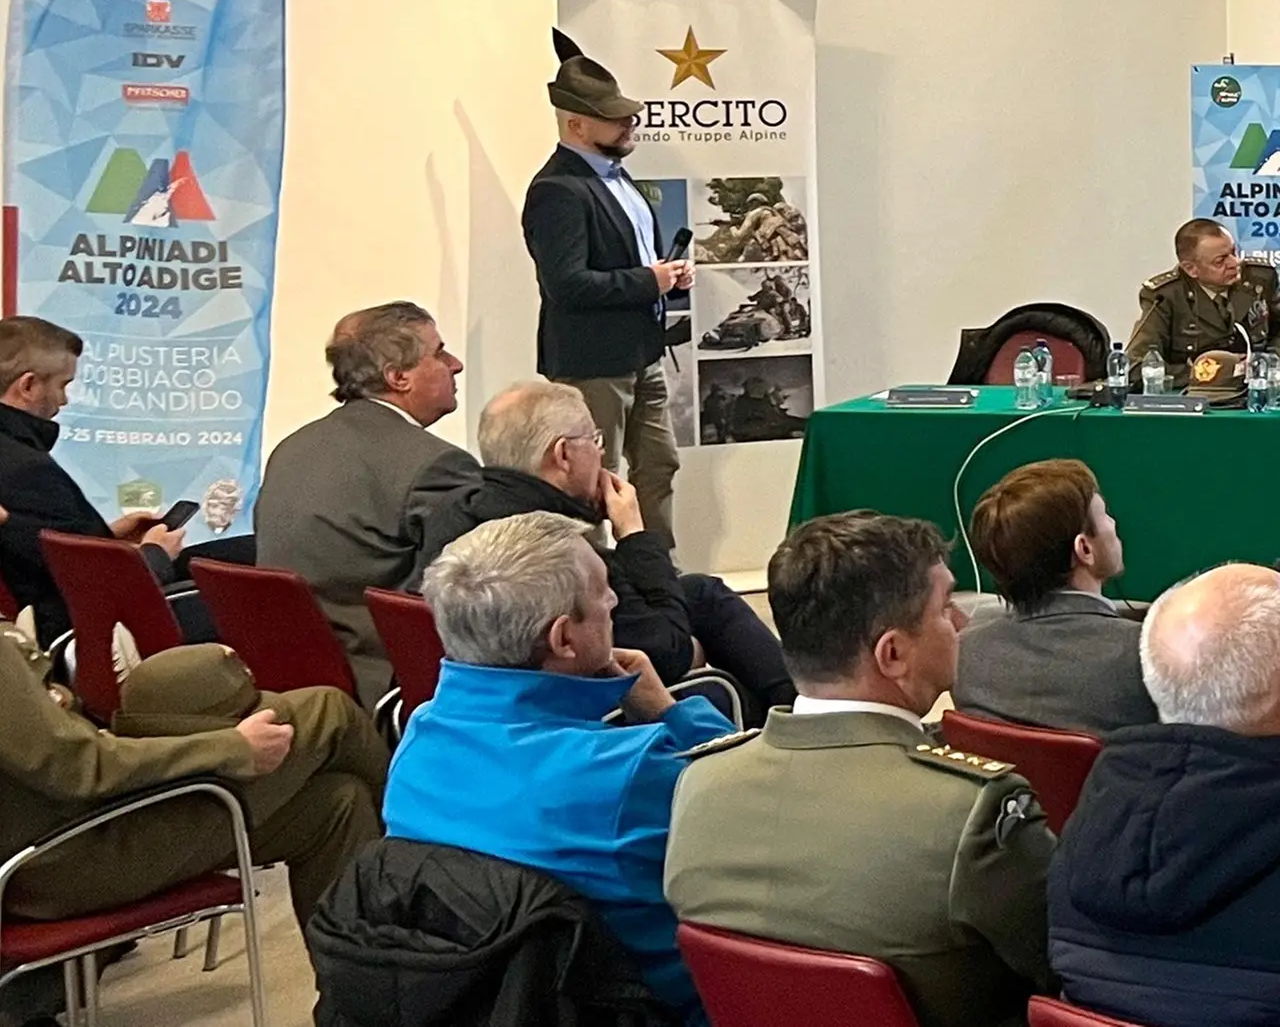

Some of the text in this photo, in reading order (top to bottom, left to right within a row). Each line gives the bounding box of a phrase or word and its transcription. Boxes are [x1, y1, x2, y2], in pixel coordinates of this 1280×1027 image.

[132, 52, 186, 68] IDV
[632, 100, 788, 128] ERCITO
[633, 130, 787, 143] ando Truppe Alpine
[1212, 201, 1270, 217] ALTO
[69, 233, 229, 264] ALPINIADI
[58, 260, 243, 291] ALTO ADIGE
[115, 292, 183, 319] 2024
[83, 340, 243, 367] AL PUSTERIA
[82, 364, 217, 389] DOBBIACO
[109, 389, 244, 412] CANDIDO
[95, 430, 192, 445] FEBBRAIO
[197, 431, 243, 445] 2024
